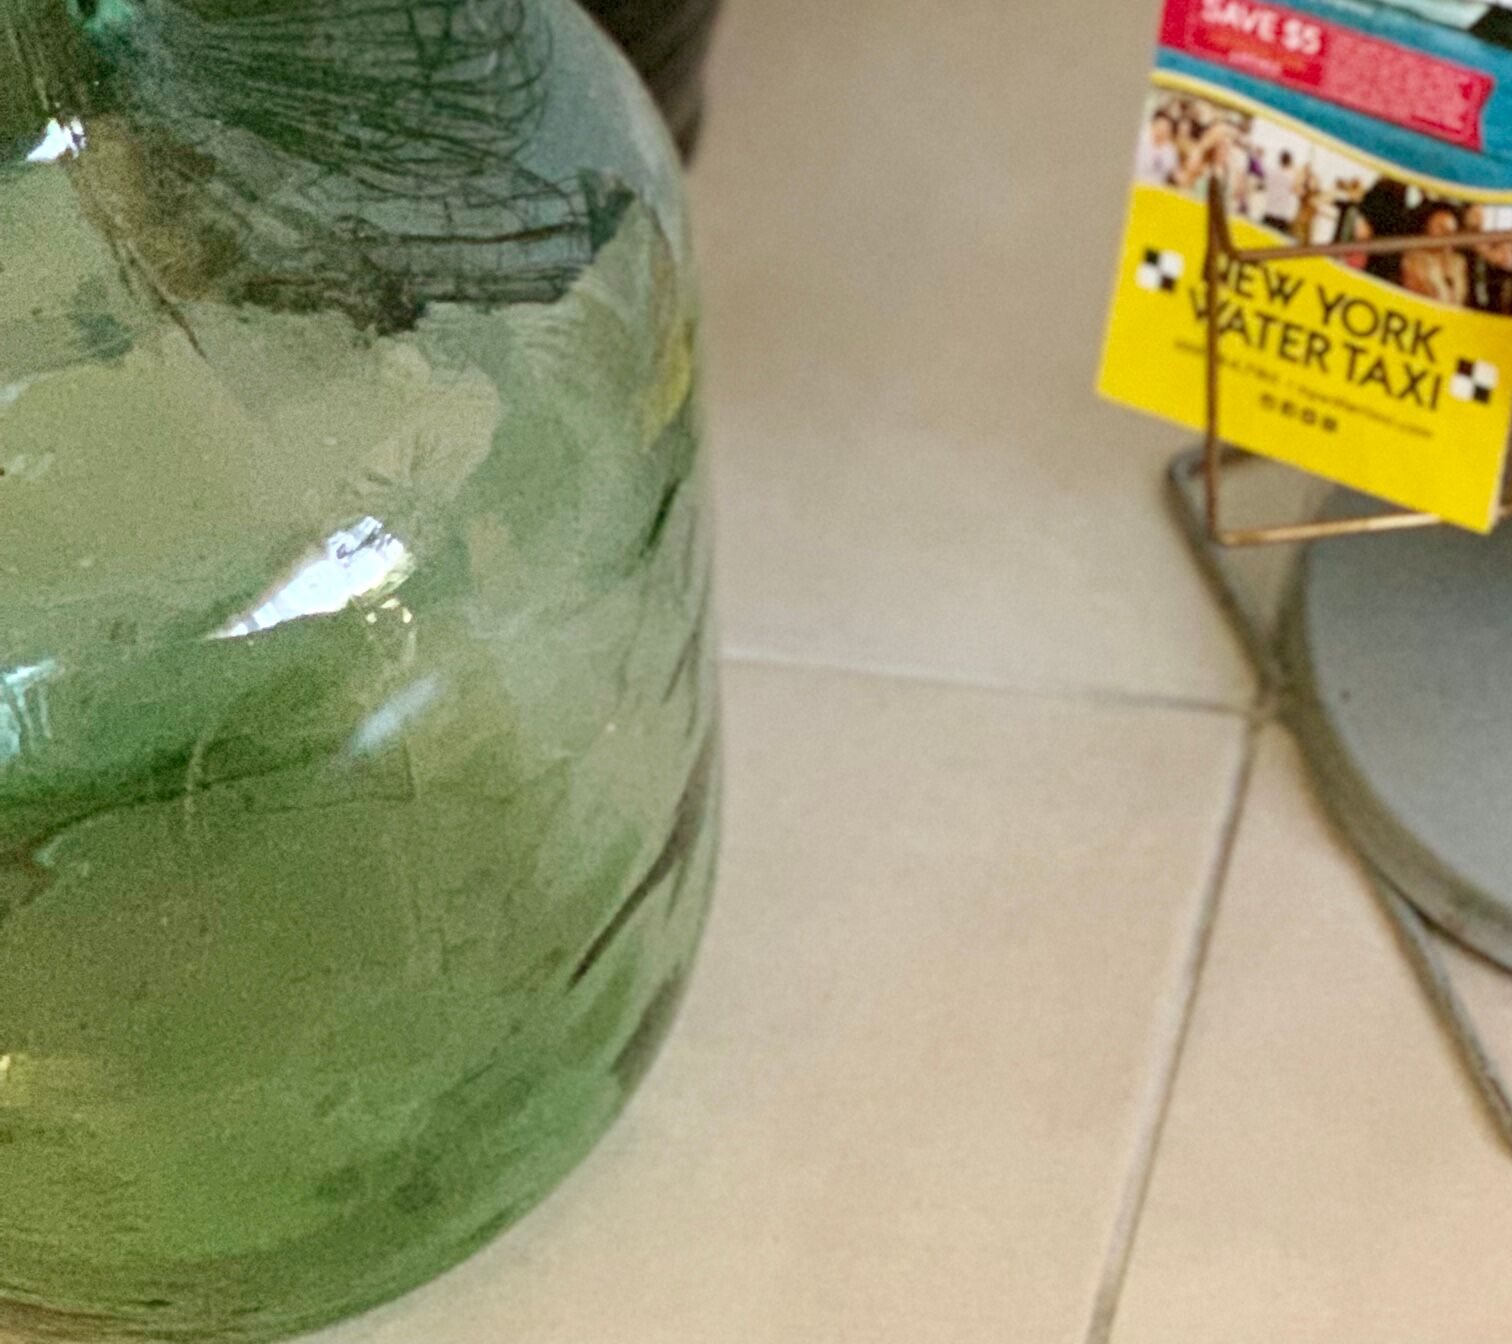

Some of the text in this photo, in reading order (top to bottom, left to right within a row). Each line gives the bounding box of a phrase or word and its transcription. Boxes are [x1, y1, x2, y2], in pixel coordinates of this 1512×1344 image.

[1279, 13, 1324, 57] $5
[1316, 284, 1442, 364] YORK
[1341, 340, 1443, 411] TAXI
